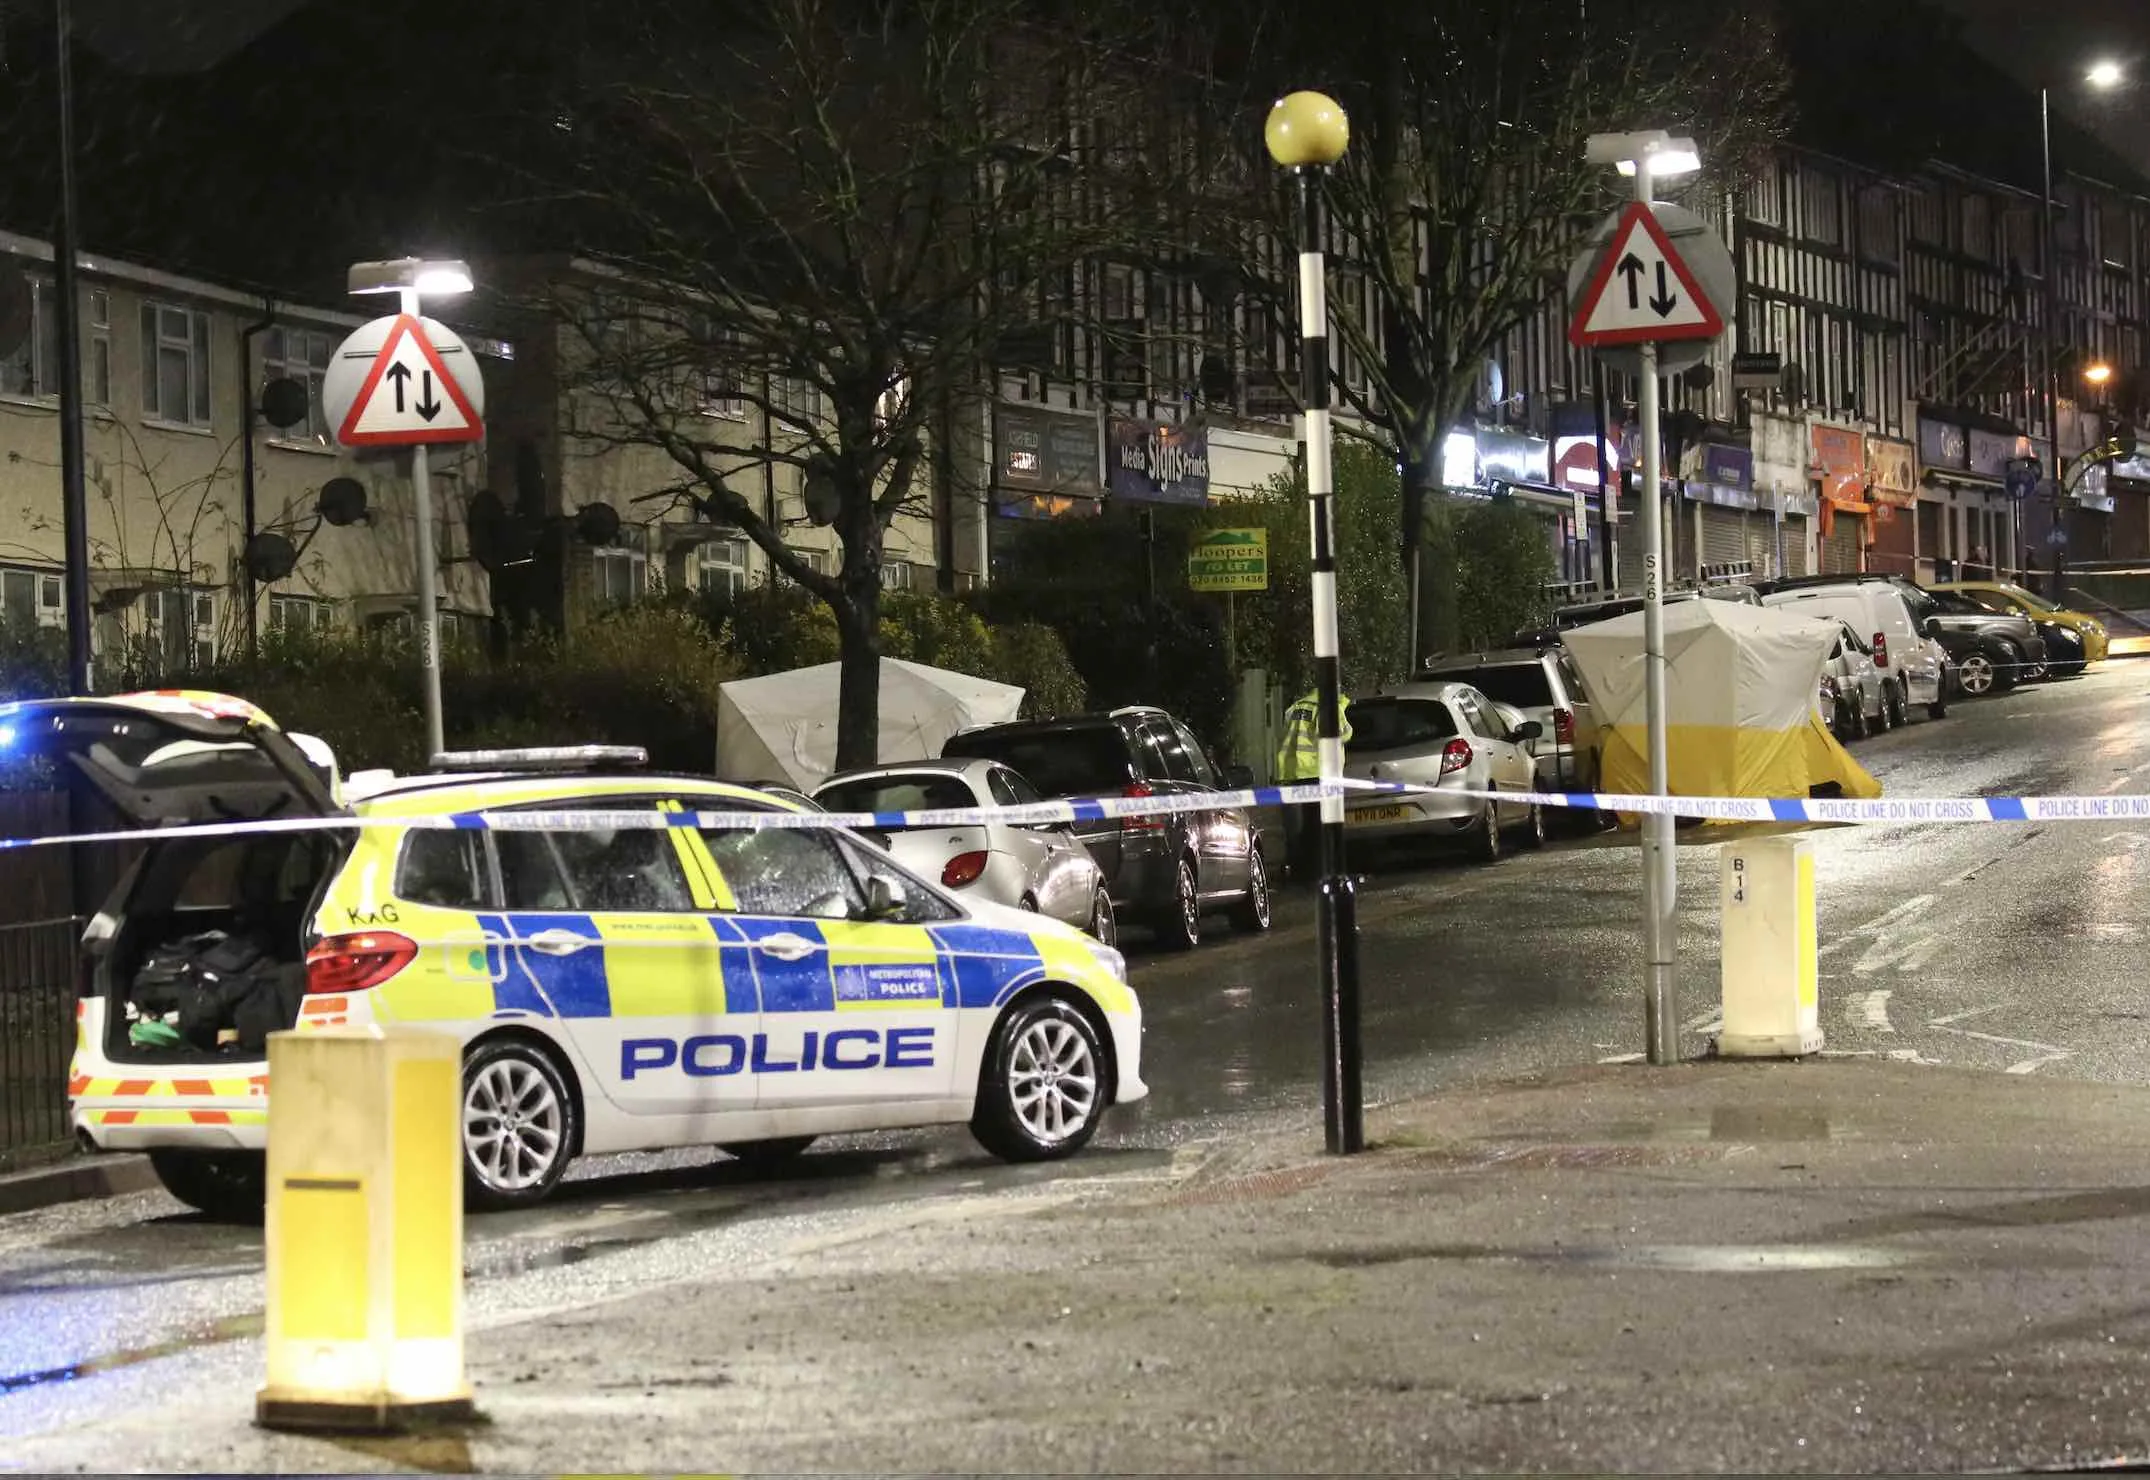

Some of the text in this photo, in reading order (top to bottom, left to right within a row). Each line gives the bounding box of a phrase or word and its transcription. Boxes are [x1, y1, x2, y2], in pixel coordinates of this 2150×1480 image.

[1121, 445, 1146, 471] Media
[1147, 433, 1183, 493] Signs
[1183, 452, 1207, 479] Prints
[1646, 554, 1657, 601] S26
[422, 622, 432, 667] S28
[1610, 798, 1758, 817] POLICE LINE DO NOT CROSS
[1818, 801, 1974, 818] POLICE LINE DO NOT CROSS
[2039, 797, 2150, 817] POLICE LINE DO NO
[501, 813, 538, 828] POLICE
[543, 813, 567, 828] LINE
[569, 813, 587, 828] DO
[614, 812, 653, 828] CROSS
[713, 815, 749, 828] POLICE
[1733, 858, 1744, 902] B14
[869, 968, 932, 980] METROPOLITAN
[880, 982, 926, 995] POLICE
[620, 1027, 935, 1080] POLICE
